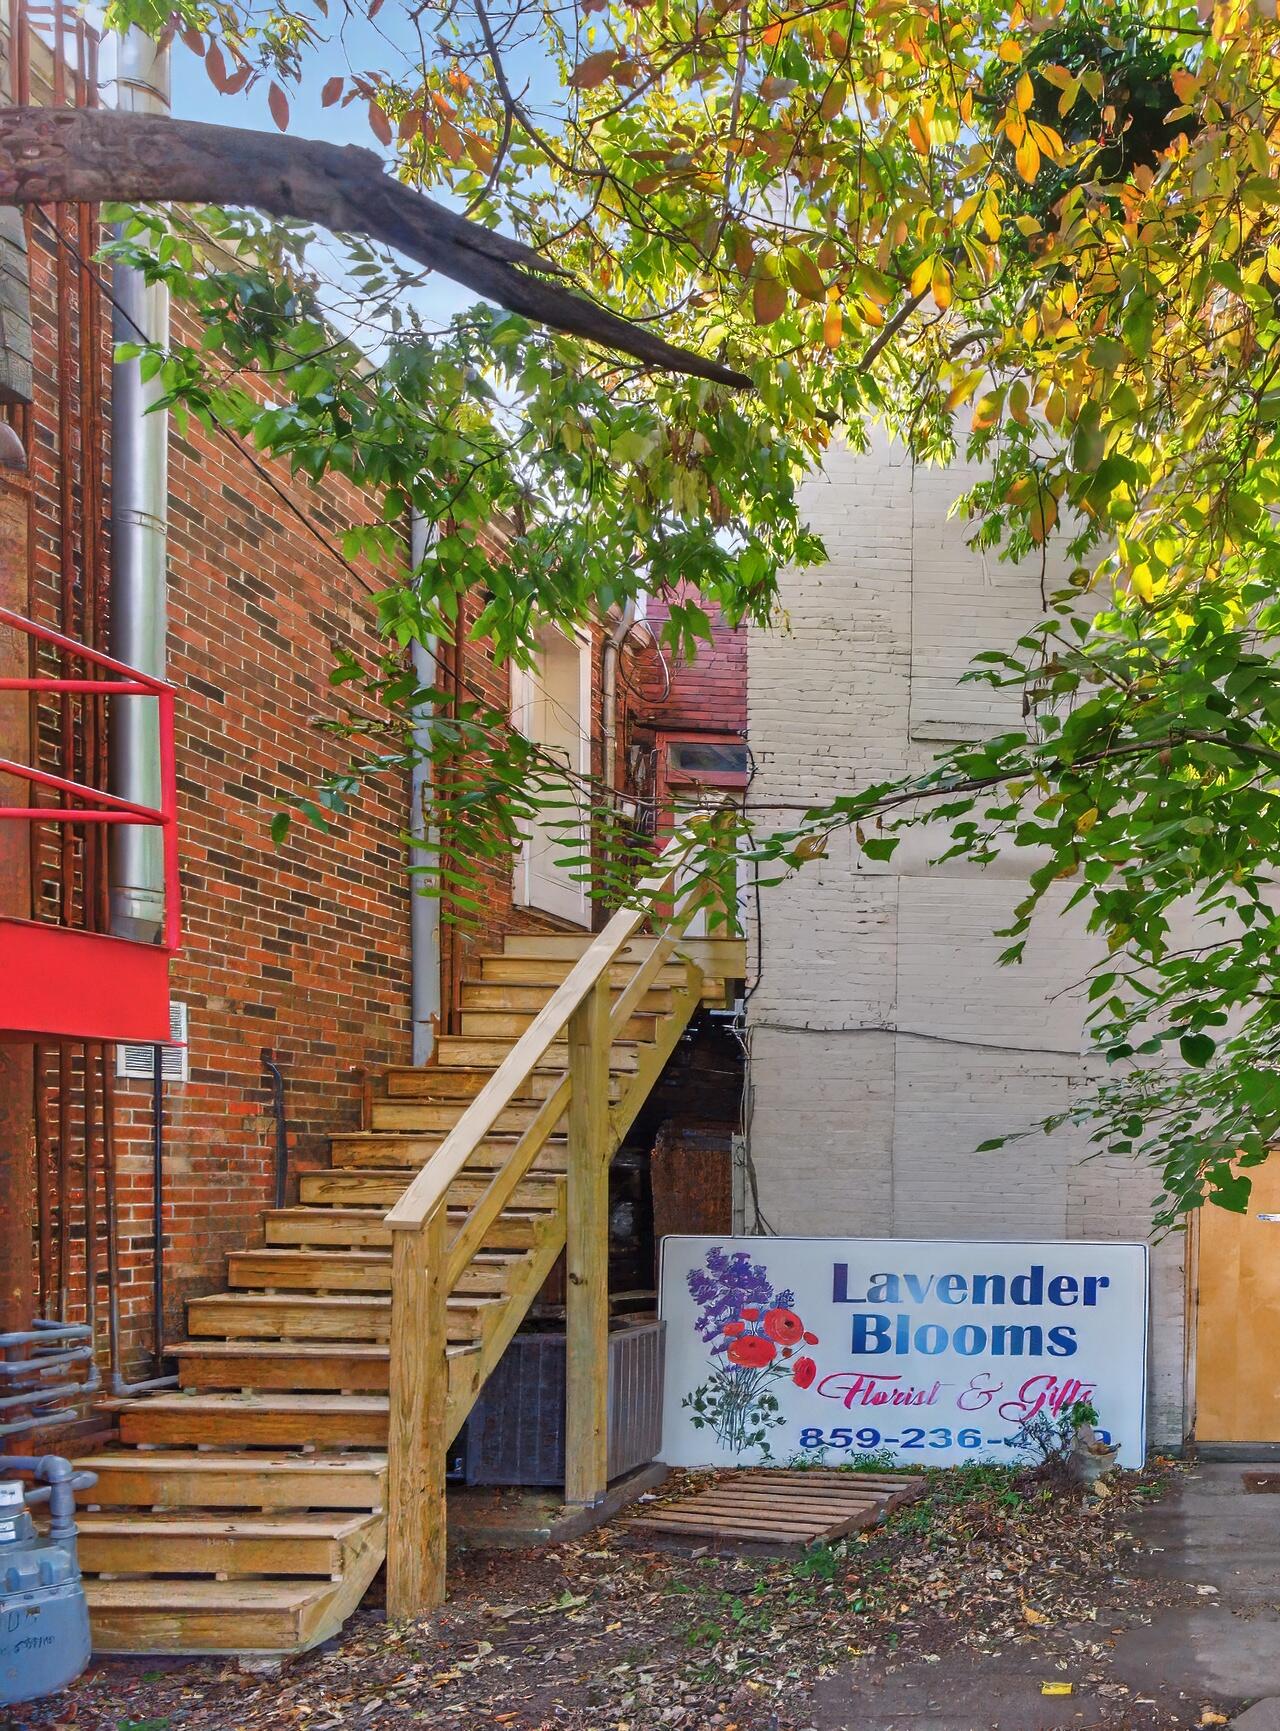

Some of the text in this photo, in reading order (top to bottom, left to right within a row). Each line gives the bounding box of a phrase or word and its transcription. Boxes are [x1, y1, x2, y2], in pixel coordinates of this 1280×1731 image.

[832, 1263, 1110, 1306] Lavender
[852, 1314, 1078, 1356] Blooms
[817, 1373, 954, 1410] Florist
[957, 1372, 1003, 1411] &
